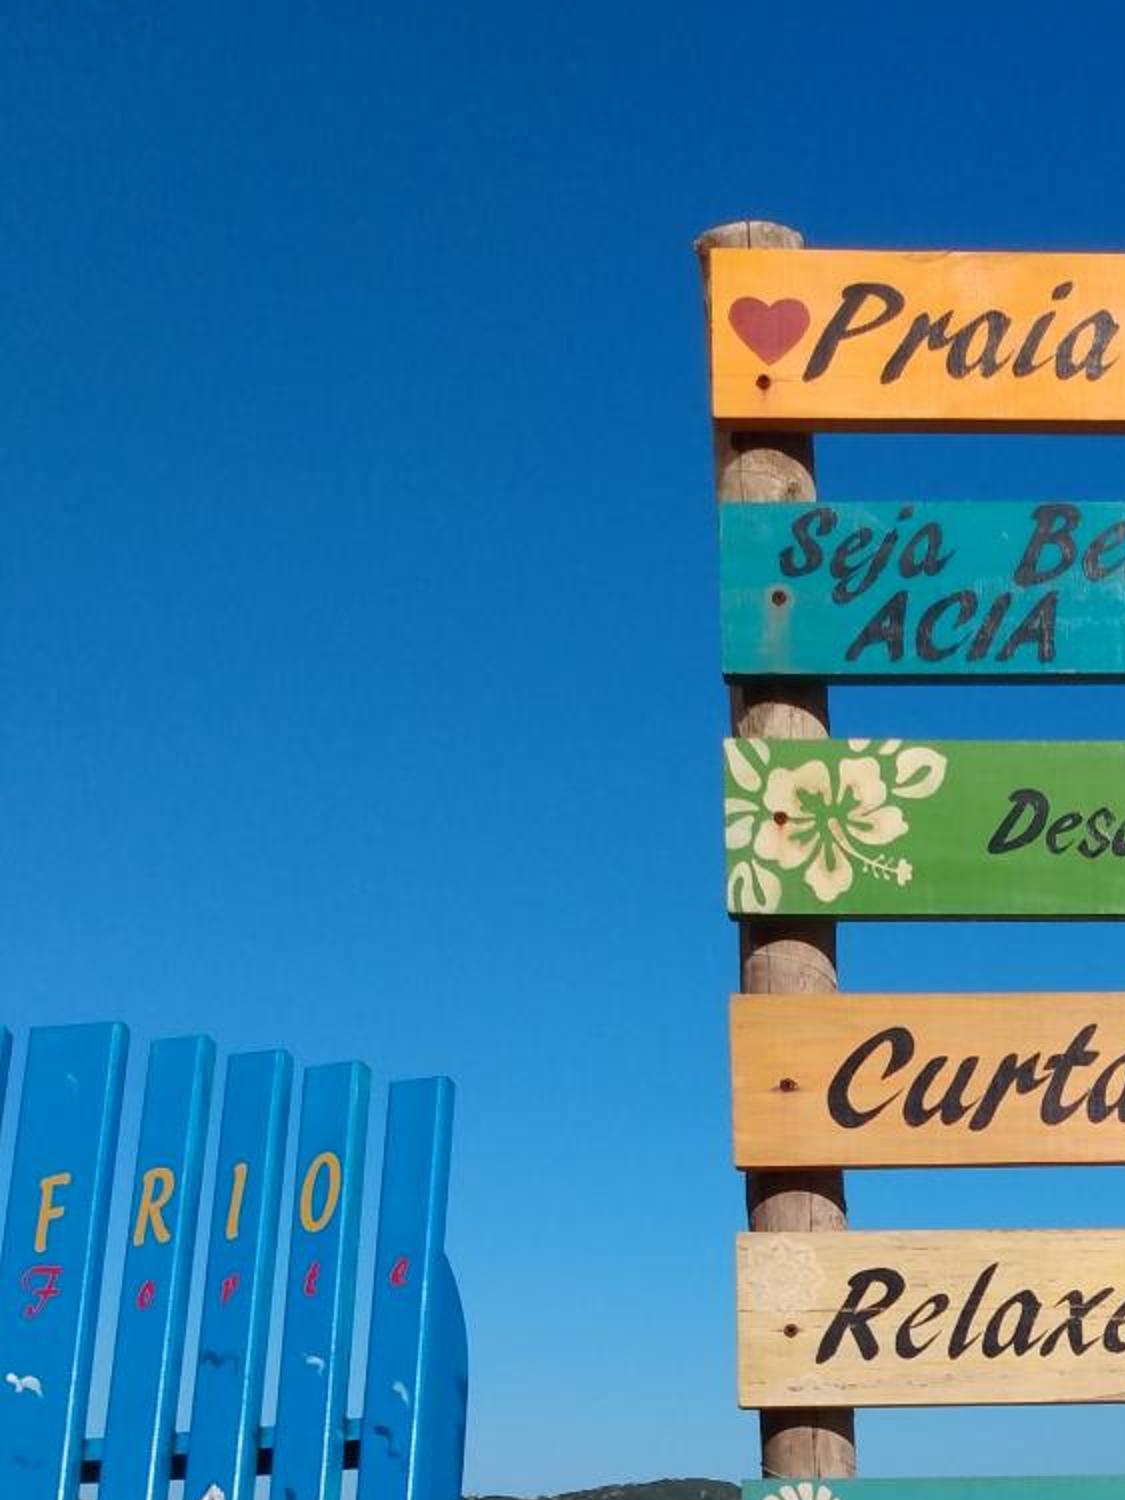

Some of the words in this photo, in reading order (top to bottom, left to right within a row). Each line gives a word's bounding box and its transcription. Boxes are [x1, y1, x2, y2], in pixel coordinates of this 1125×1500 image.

[803, 281, 1120, 384] Praia
[778, 506, 956, 604] Seja
[845, 590, 1060, 664] ACIA
[33, 1151, 342, 1253] FRIO
[21, 1258, 410, 1317] Forte
